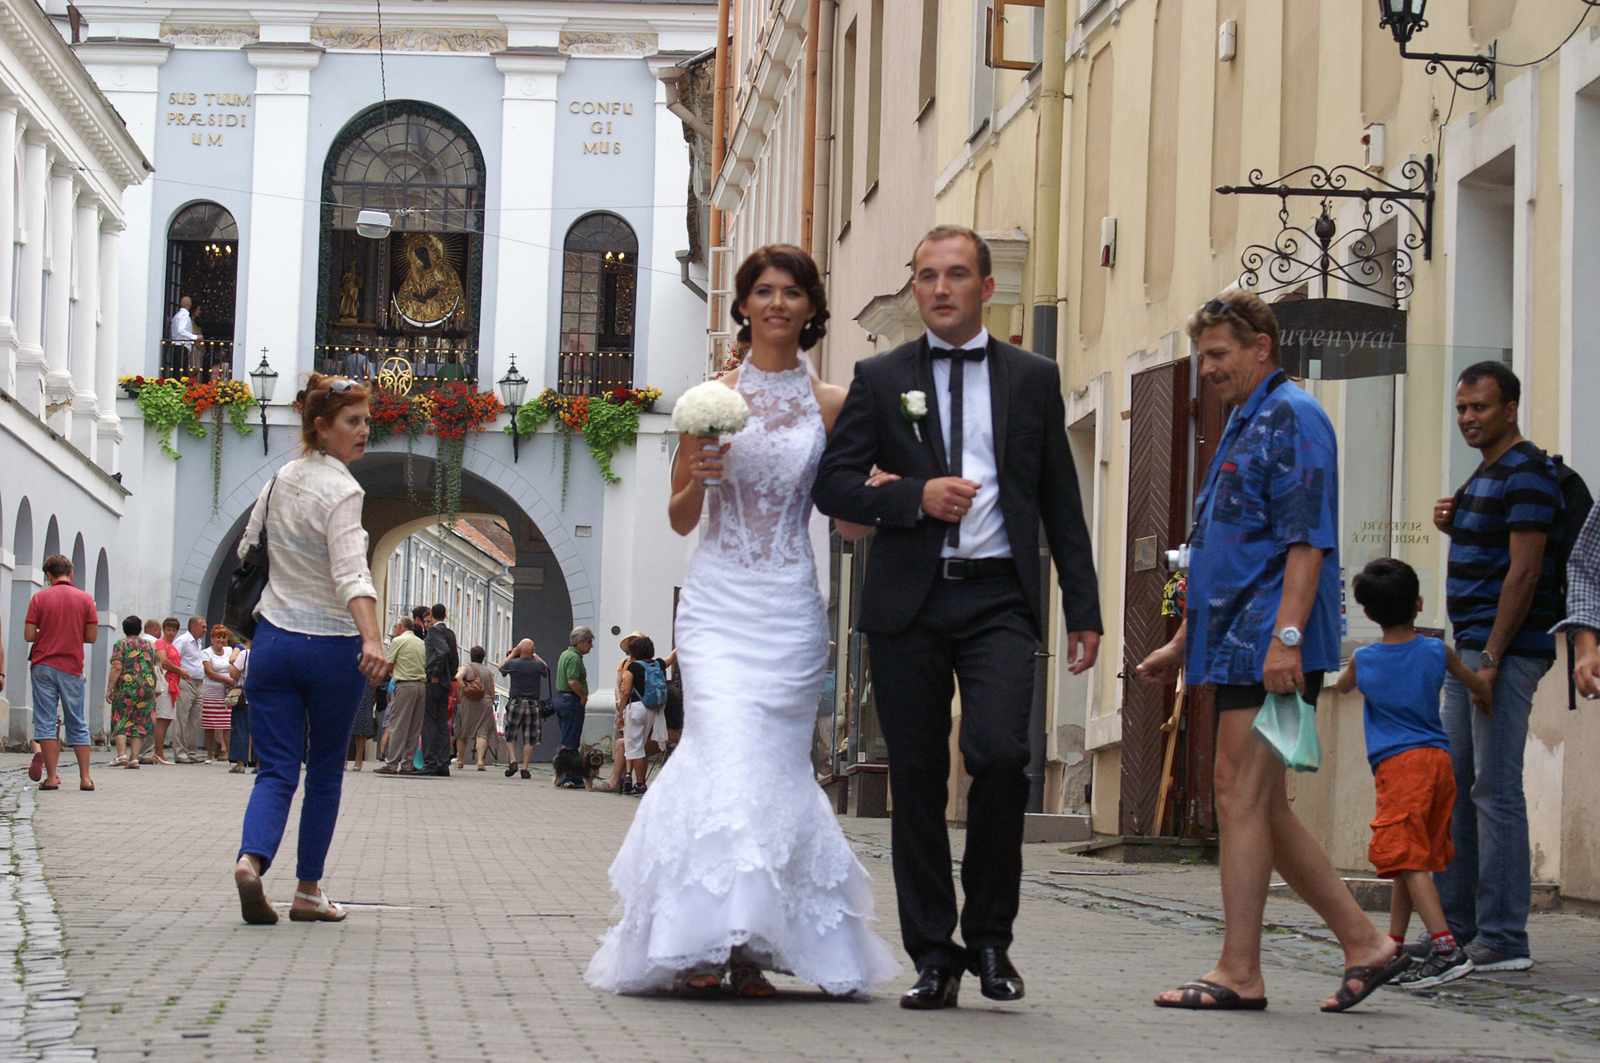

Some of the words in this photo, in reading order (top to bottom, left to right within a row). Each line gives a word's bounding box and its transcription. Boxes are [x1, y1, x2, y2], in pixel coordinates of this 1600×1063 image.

[169, 92, 198, 106] SUB
[203, 93, 252, 107] TUUM
[569, 101, 633, 115] CONFU
[591, 121, 613, 134] GI
[583, 142, 621, 155] MUS
[1279, 323, 1398, 356] uvenyrai
